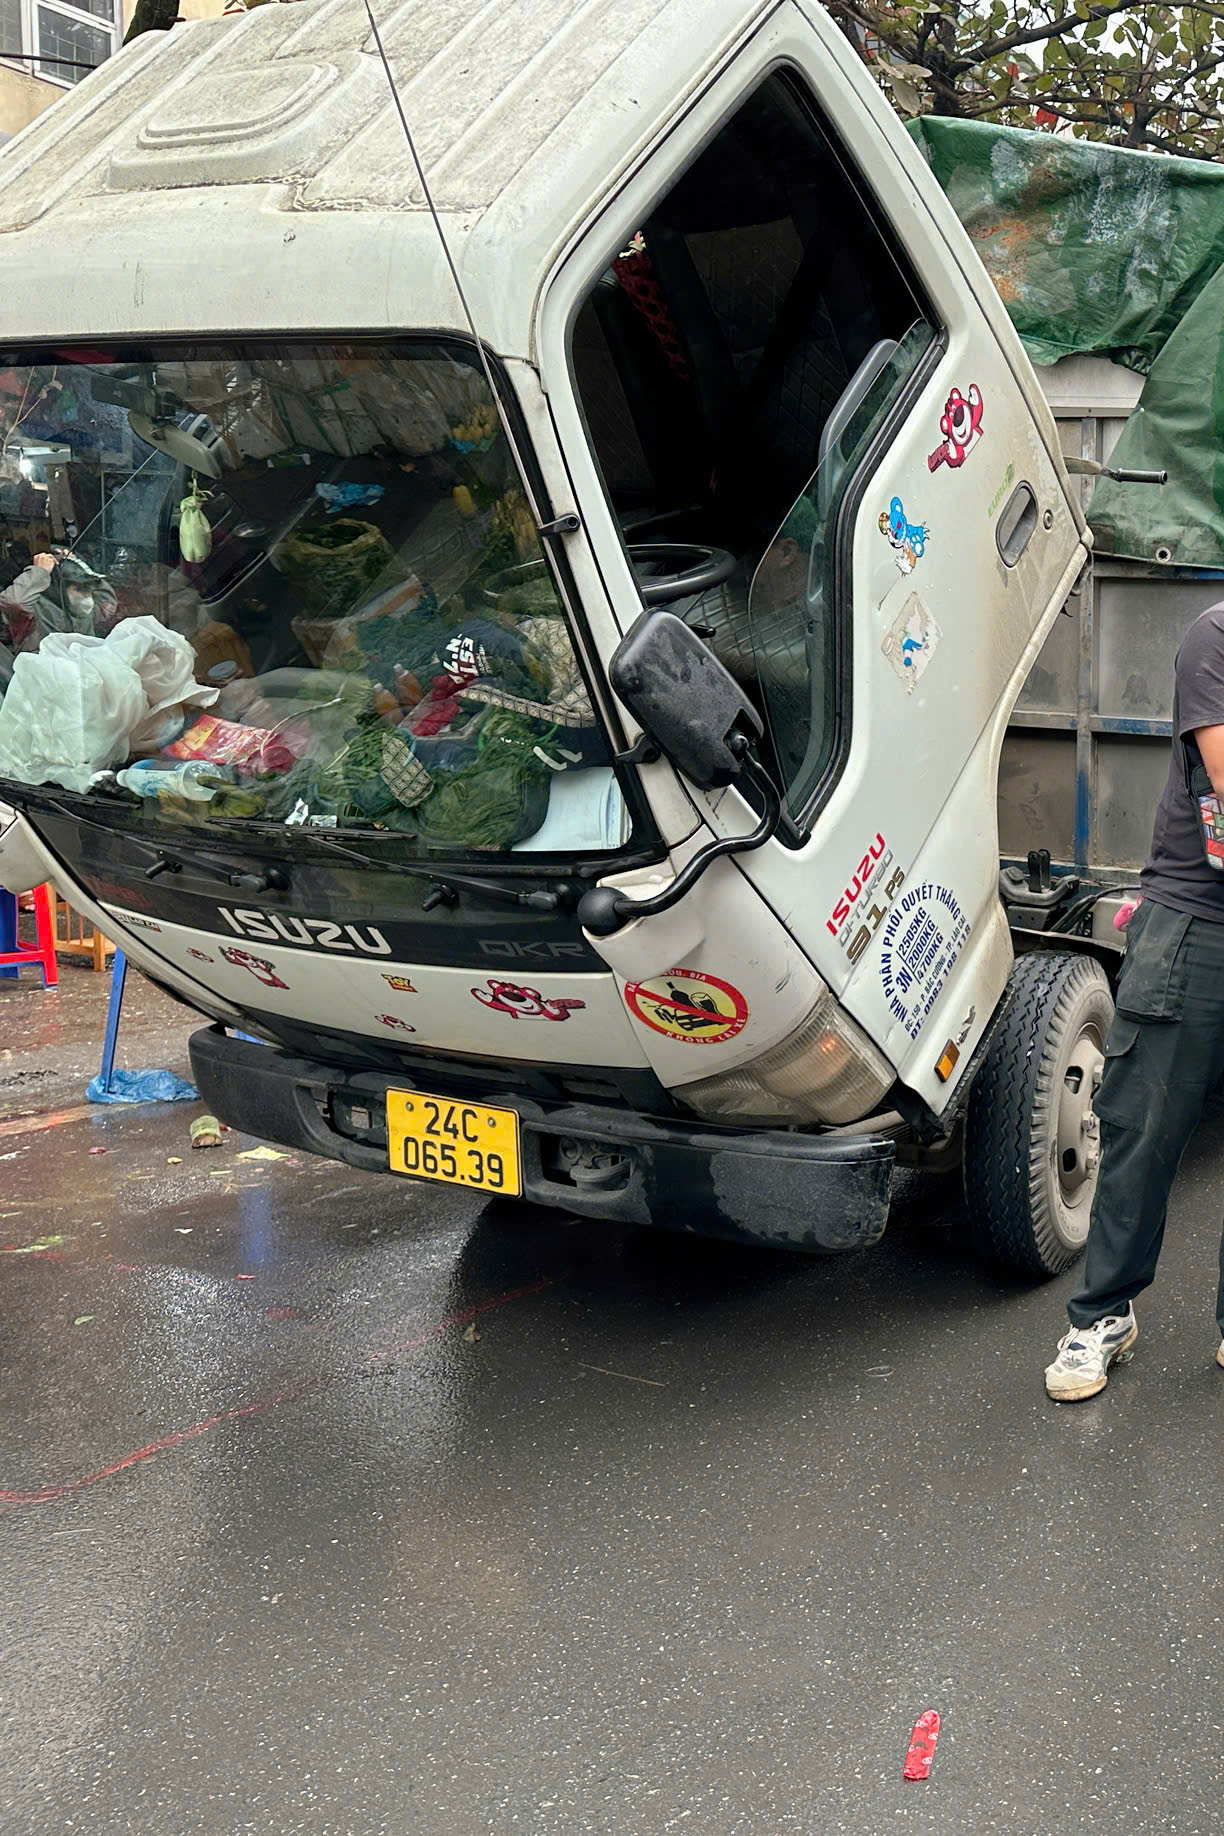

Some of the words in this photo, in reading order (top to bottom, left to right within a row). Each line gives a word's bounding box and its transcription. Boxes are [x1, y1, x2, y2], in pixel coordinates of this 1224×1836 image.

[826, 833, 886, 936] ISUZU
[838, 849, 893, 948] DI-TURBO
[901, 880, 933, 912] QUYẾT
[217, 907, 392, 954] ISUZU
[846, 903, 888, 965] 91
[884, 866, 905, 901] PS
[898, 906, 927, 956] 2505KG
[908, 919, 937, 969] 2000KG
[917, 932, 944, 980] 4700KG
[879, 953, 895, 998] PHÂN
[895, 967, 913, 994] 3N
[923, 980, 943, 1016] 0983
[888, 995, 909, 1023] NHÀ
[424, 1101, 479, 1143] 24C
[403, 1136, 504, 1188] 065.39
